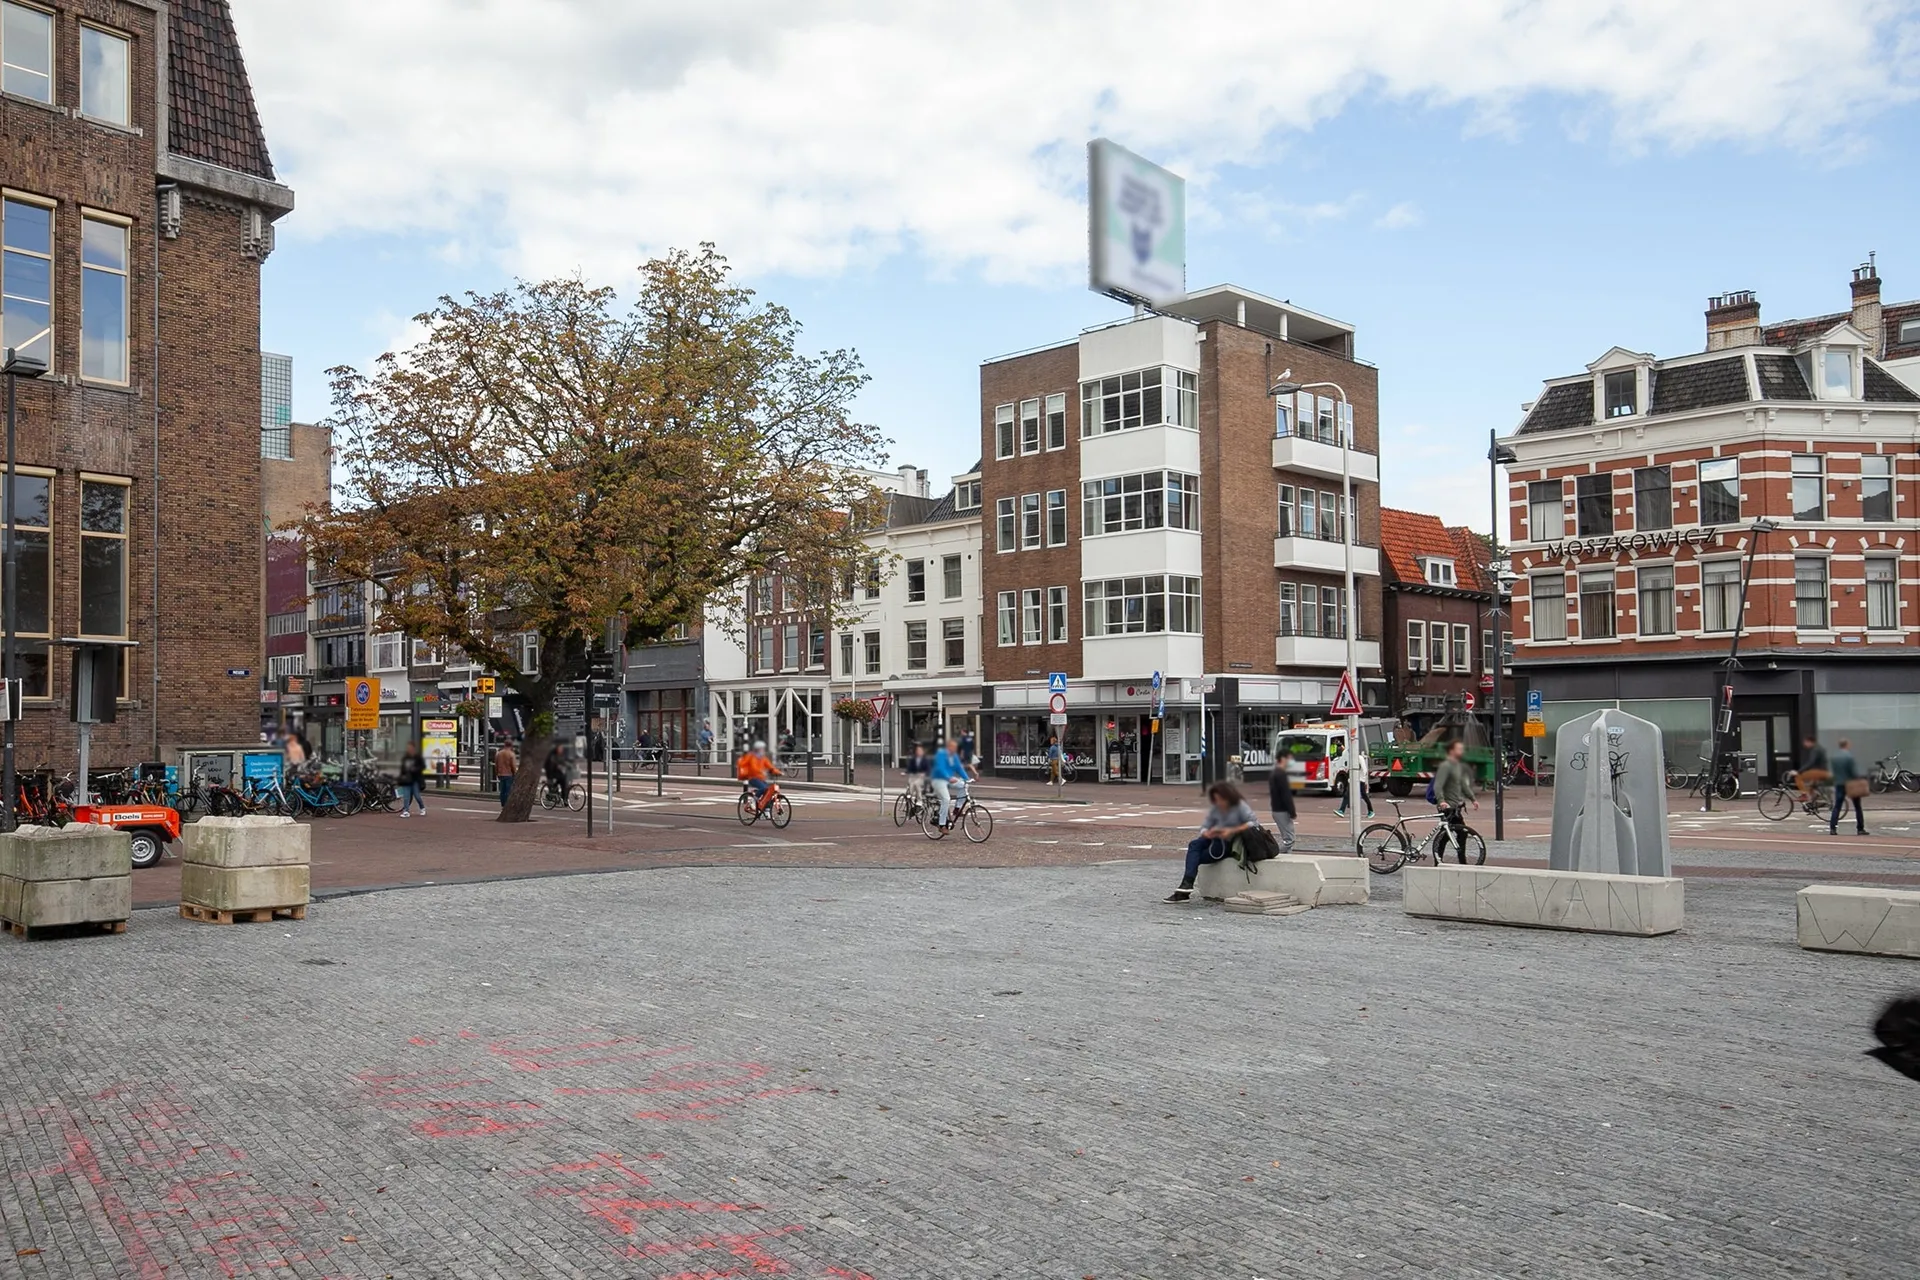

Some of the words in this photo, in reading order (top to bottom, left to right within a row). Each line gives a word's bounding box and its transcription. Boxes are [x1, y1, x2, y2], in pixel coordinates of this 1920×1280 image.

[1548, 527, 1718, 558] MOSZKOWICZ
[1530, 692, 1539, 704] P
[1000, 755, 1027, 765] ZONNE
[1528, 875, 1644, 933] VAN
